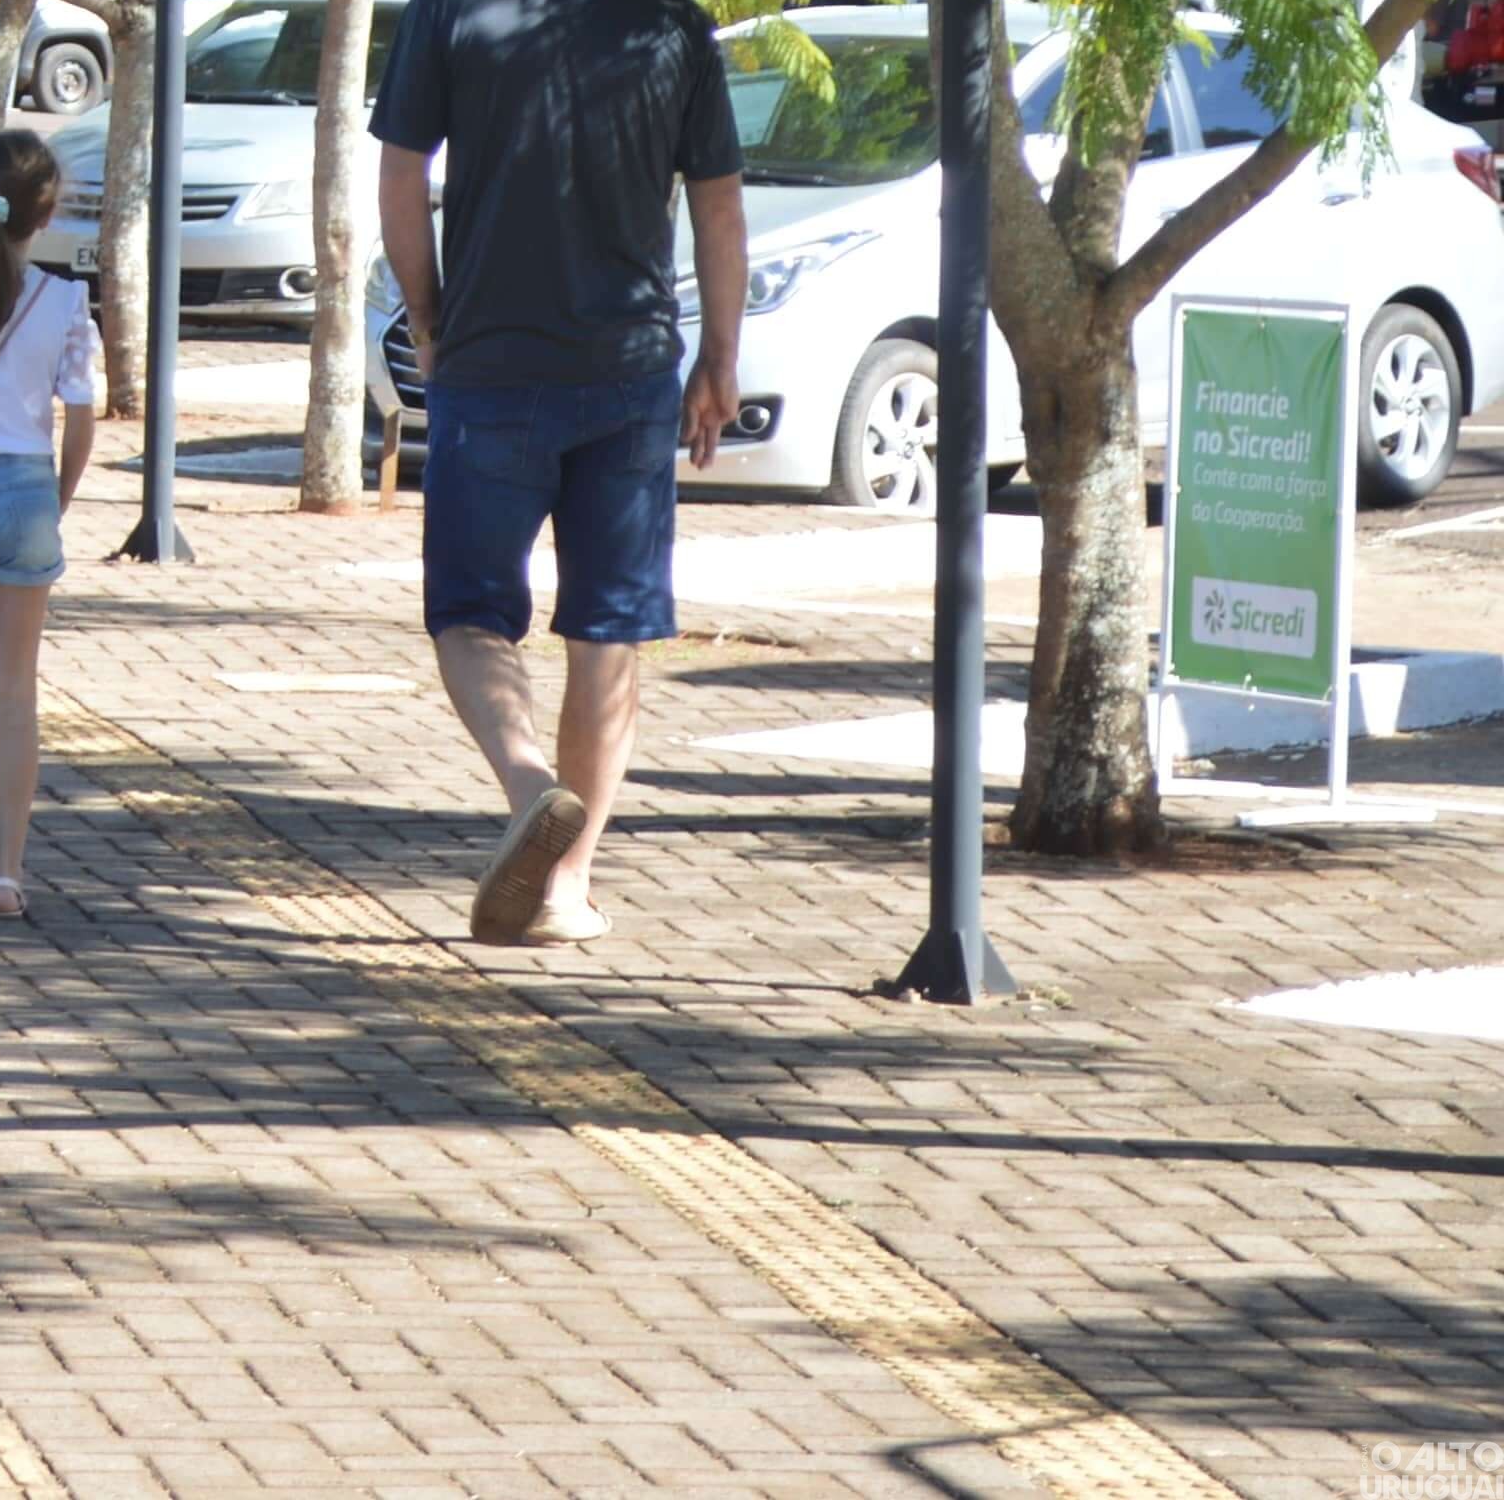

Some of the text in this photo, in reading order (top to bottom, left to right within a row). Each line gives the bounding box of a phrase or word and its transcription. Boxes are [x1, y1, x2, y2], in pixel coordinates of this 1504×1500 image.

[1195, 380, 1289, 420] Financie
[1193, 424, 1311, 464] no Sicredi!
[1193, 461, 1328, 504] Conte com a força
[1230, 600, 1306, 638] Sicredi
